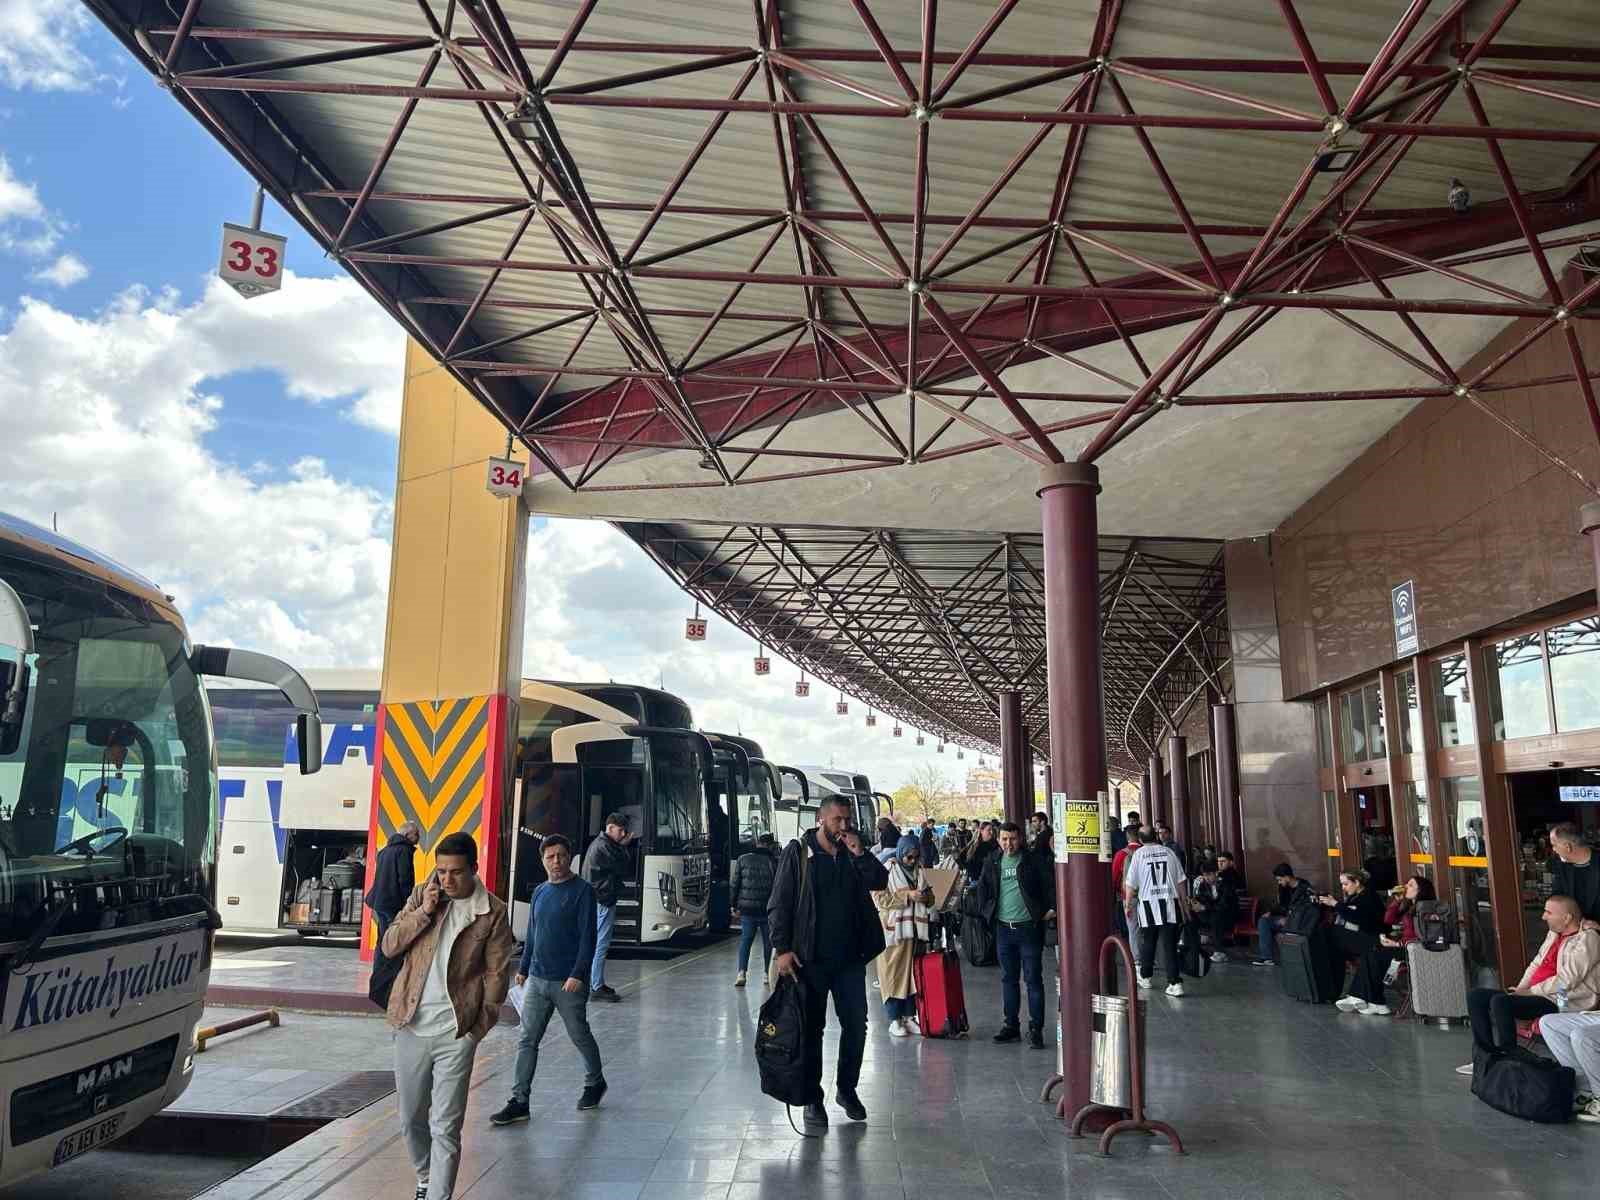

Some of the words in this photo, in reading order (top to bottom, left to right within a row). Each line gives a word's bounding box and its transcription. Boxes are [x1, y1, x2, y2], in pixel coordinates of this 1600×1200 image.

[227, 240, 278, 278] 33
[491, 466, 520, 489] 34
[687, 623, 705, 637] 35
[755, 661, 769, 672] 36
[796, 685, 809, 696] 37
[1067, 802, 1098, 812] DİKKAT
[1069, 837, 1098, 845] CAUTION
[1147, 861, 1168, 886] 17
[10, 942, 200, 1032] Kütahyalılar
[76, 1055, 133, 1095] MAN
